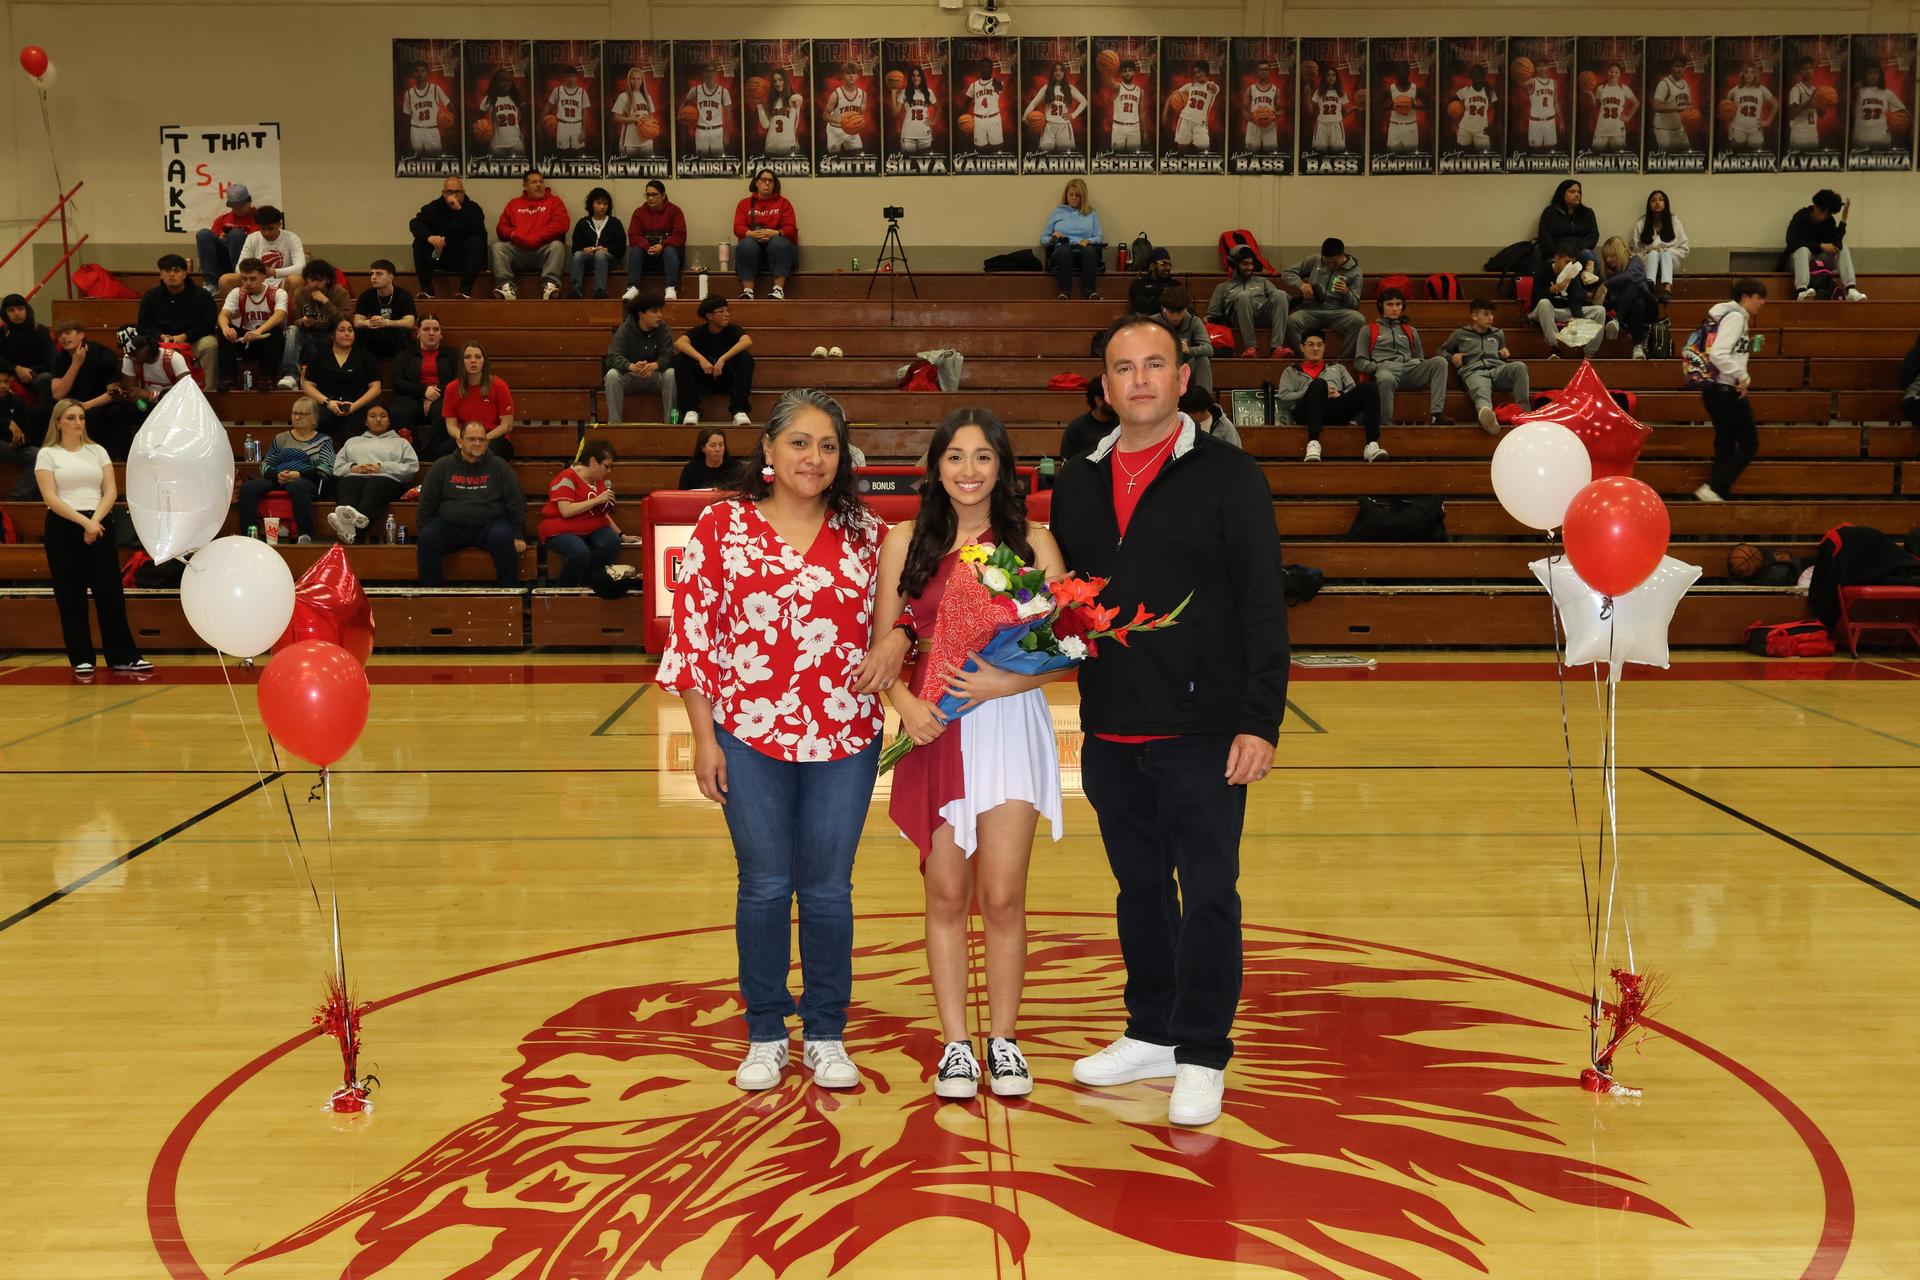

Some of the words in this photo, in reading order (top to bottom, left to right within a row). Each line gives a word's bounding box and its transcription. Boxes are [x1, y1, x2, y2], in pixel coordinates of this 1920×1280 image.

[911, 109, 924, 121] 15
[201, 131, 267, 153] THAT
[397, 161, 460, 176] AGUILAR
[466, 161, 530, 176] CARTER
[535, 161, 601, 176] WALTERS
[607, 161, 668, 176] NEWTON
[677, 161, 742, 176] BEARDSLEY
[747, 161, 810, 176] PARSONS
[820, 159, 876, 174] SMITH
[885, 159, 947, 174] SILVA
[952, 159, 1018, 173] VAUGHN
[1022, 158, 1087, 173] MARION
[1091, 158, 1155, 173] ESCHEIK
[1159, 158, 1225, 173] ESCHEIK
[1236, 158, 1284, 172] BASS
[1306, 158, 1358, 174] BASS
[1371, 159, 1432, 172] HEMPHILL
[1440, 158, 1502, 172] MOORE
[1506, 157, 1570, 170] DEATHERAGE
[1575, 157, 1640, 170] GONSALVES
[1648, 157, 1704, 171] ROMINE
[1713, 156, 1777, 170] MARCEAUX
[1849, 155, 1911, 170] MENDOZA
[165, 133, 188, 232] TAKE
[872, 481, 895, 491] BONUS
